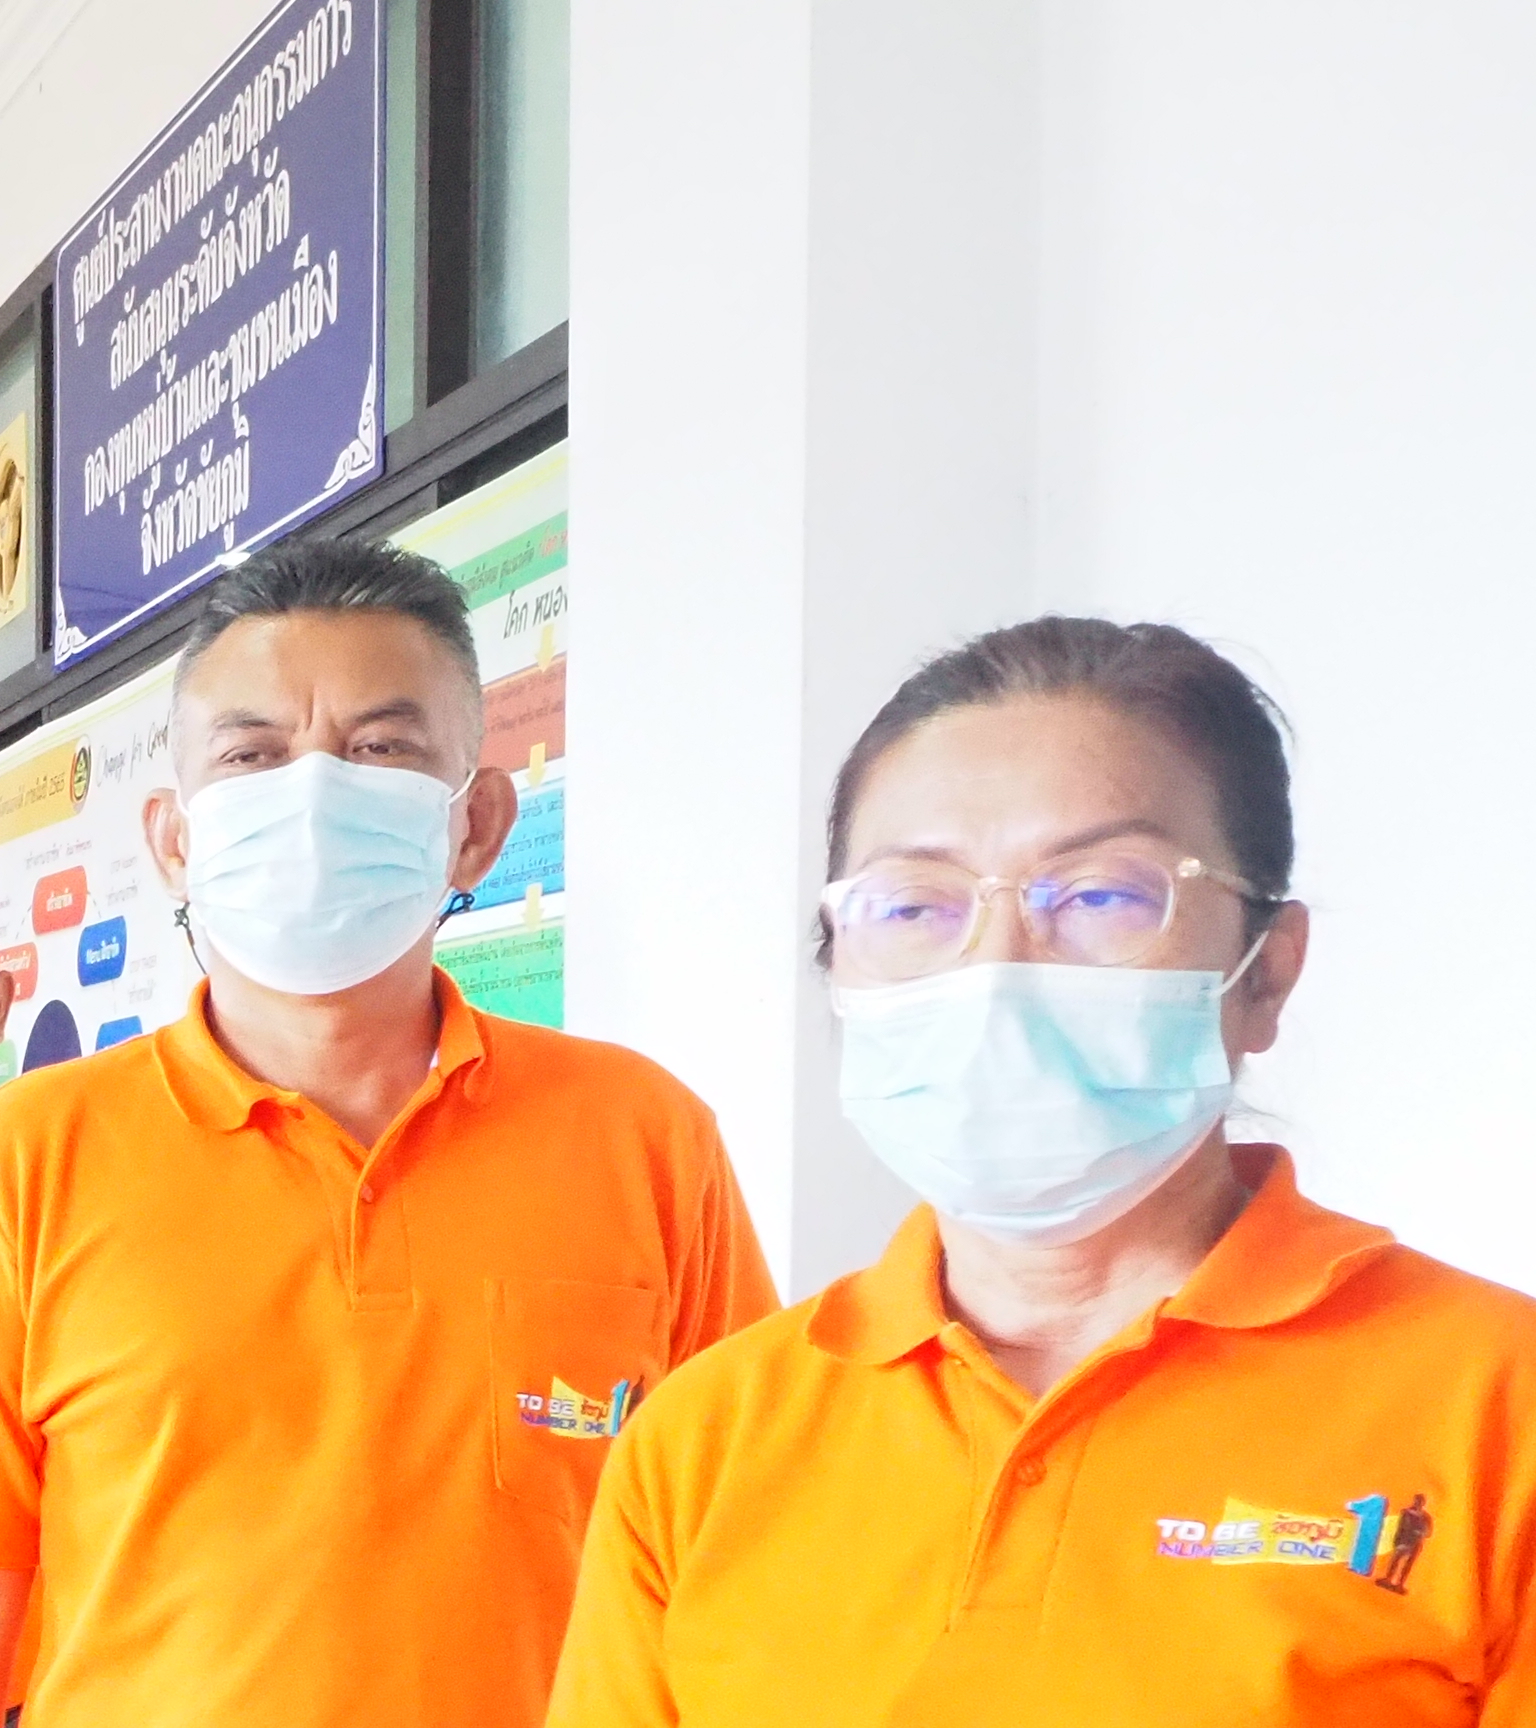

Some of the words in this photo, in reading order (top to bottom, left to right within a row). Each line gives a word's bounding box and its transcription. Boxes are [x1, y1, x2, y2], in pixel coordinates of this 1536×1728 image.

[73, 0, 352, 346] ศูนย์ประสานงานคณะอนุกรรมการ
[109, 147, 291, 391] สนับสนุนระดับจังหวัด
[84, 236, 339, 516] กองทุนหมู่บ้านและชุมชนเมือง
[139, 422, 252, 575] จังหวัดชัยภูมิ
[516, 1393, 543, 1411] TO
[548, 1398, 575, 1416] BE
[1156, 1518, 1206, 1541] TO
[1212, 1520, 1260, 1542] BE
[1158, 1540, 1263, 1558] NUMBER
[1278, 1540, 1337, 1560] ONE
